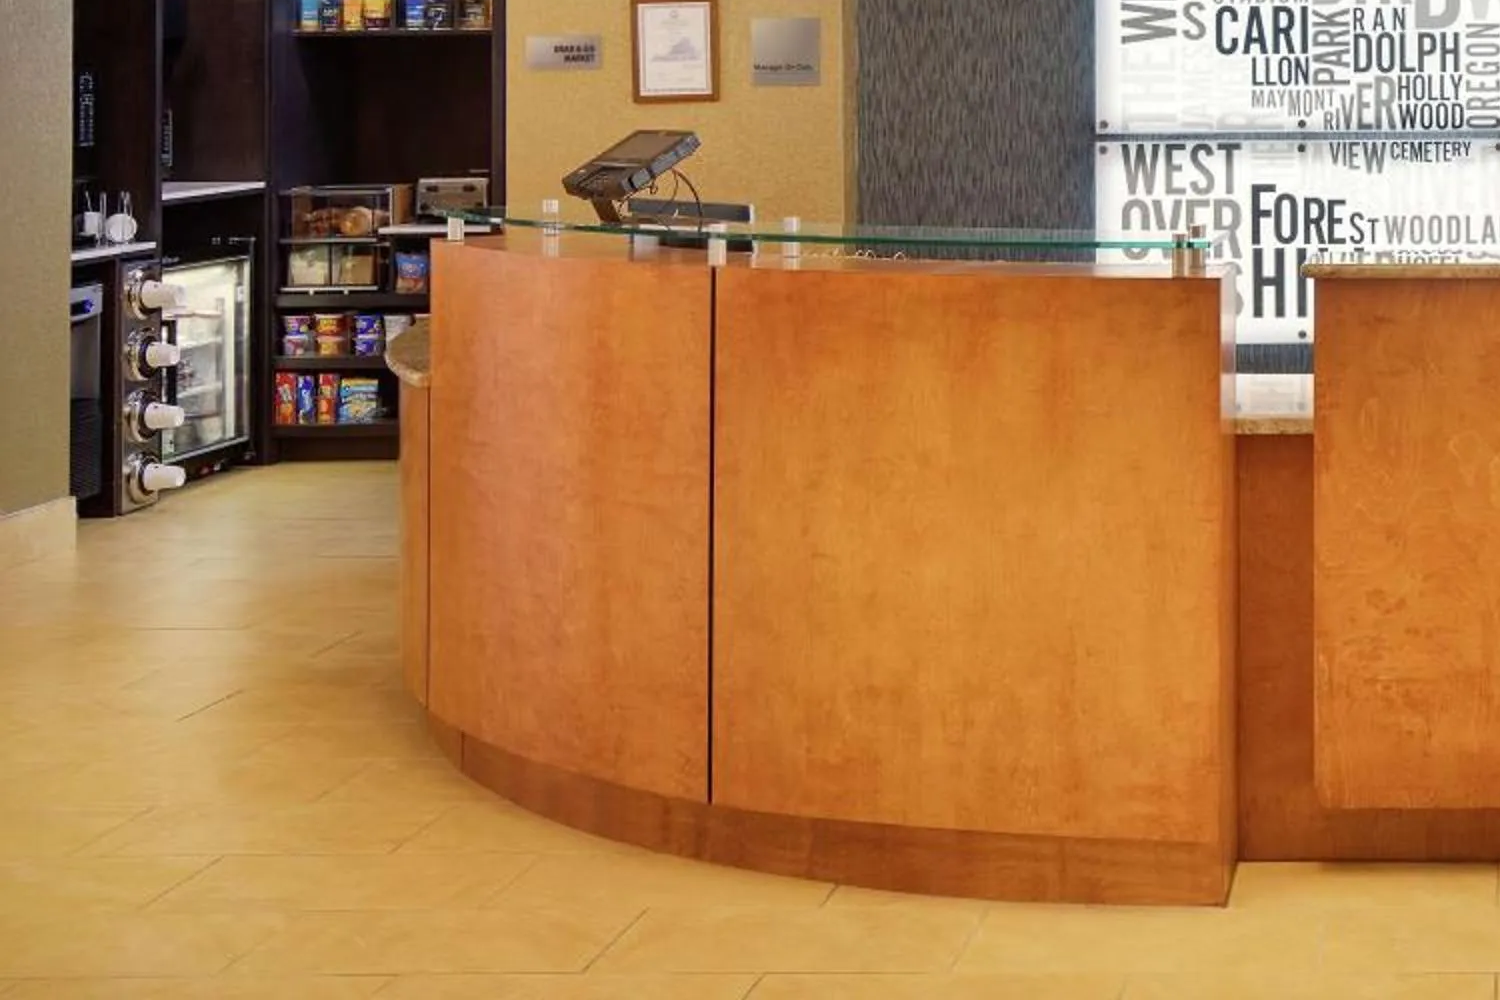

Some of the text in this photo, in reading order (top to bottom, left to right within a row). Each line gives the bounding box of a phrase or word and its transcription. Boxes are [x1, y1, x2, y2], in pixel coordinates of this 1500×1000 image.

[1216, 6, 1308, 54] CARI
[1354, 8, 1405, 30] RAN
[563, 54, 596, 63] MARKET
[1312, 8, 1350, 85] PARK
[1354, 33, 1459, 73] DOLPH
[1252, 57, 1308, 85] LLON
[1252, 89, 1333, 116] MAYMONT
[1398, 75, 1463, 100] HOLLY
[1323, 77, 1397, 130] RIVER
[1400, 104, 1463, 129] WOOD
[1121, 144, 1242, 195] WEST
[1329, 142, 1386, 173] VIEW
[1390, 142, 1471, 163] CEMETERY
[1252, 184, 1379, 245] FOREST
